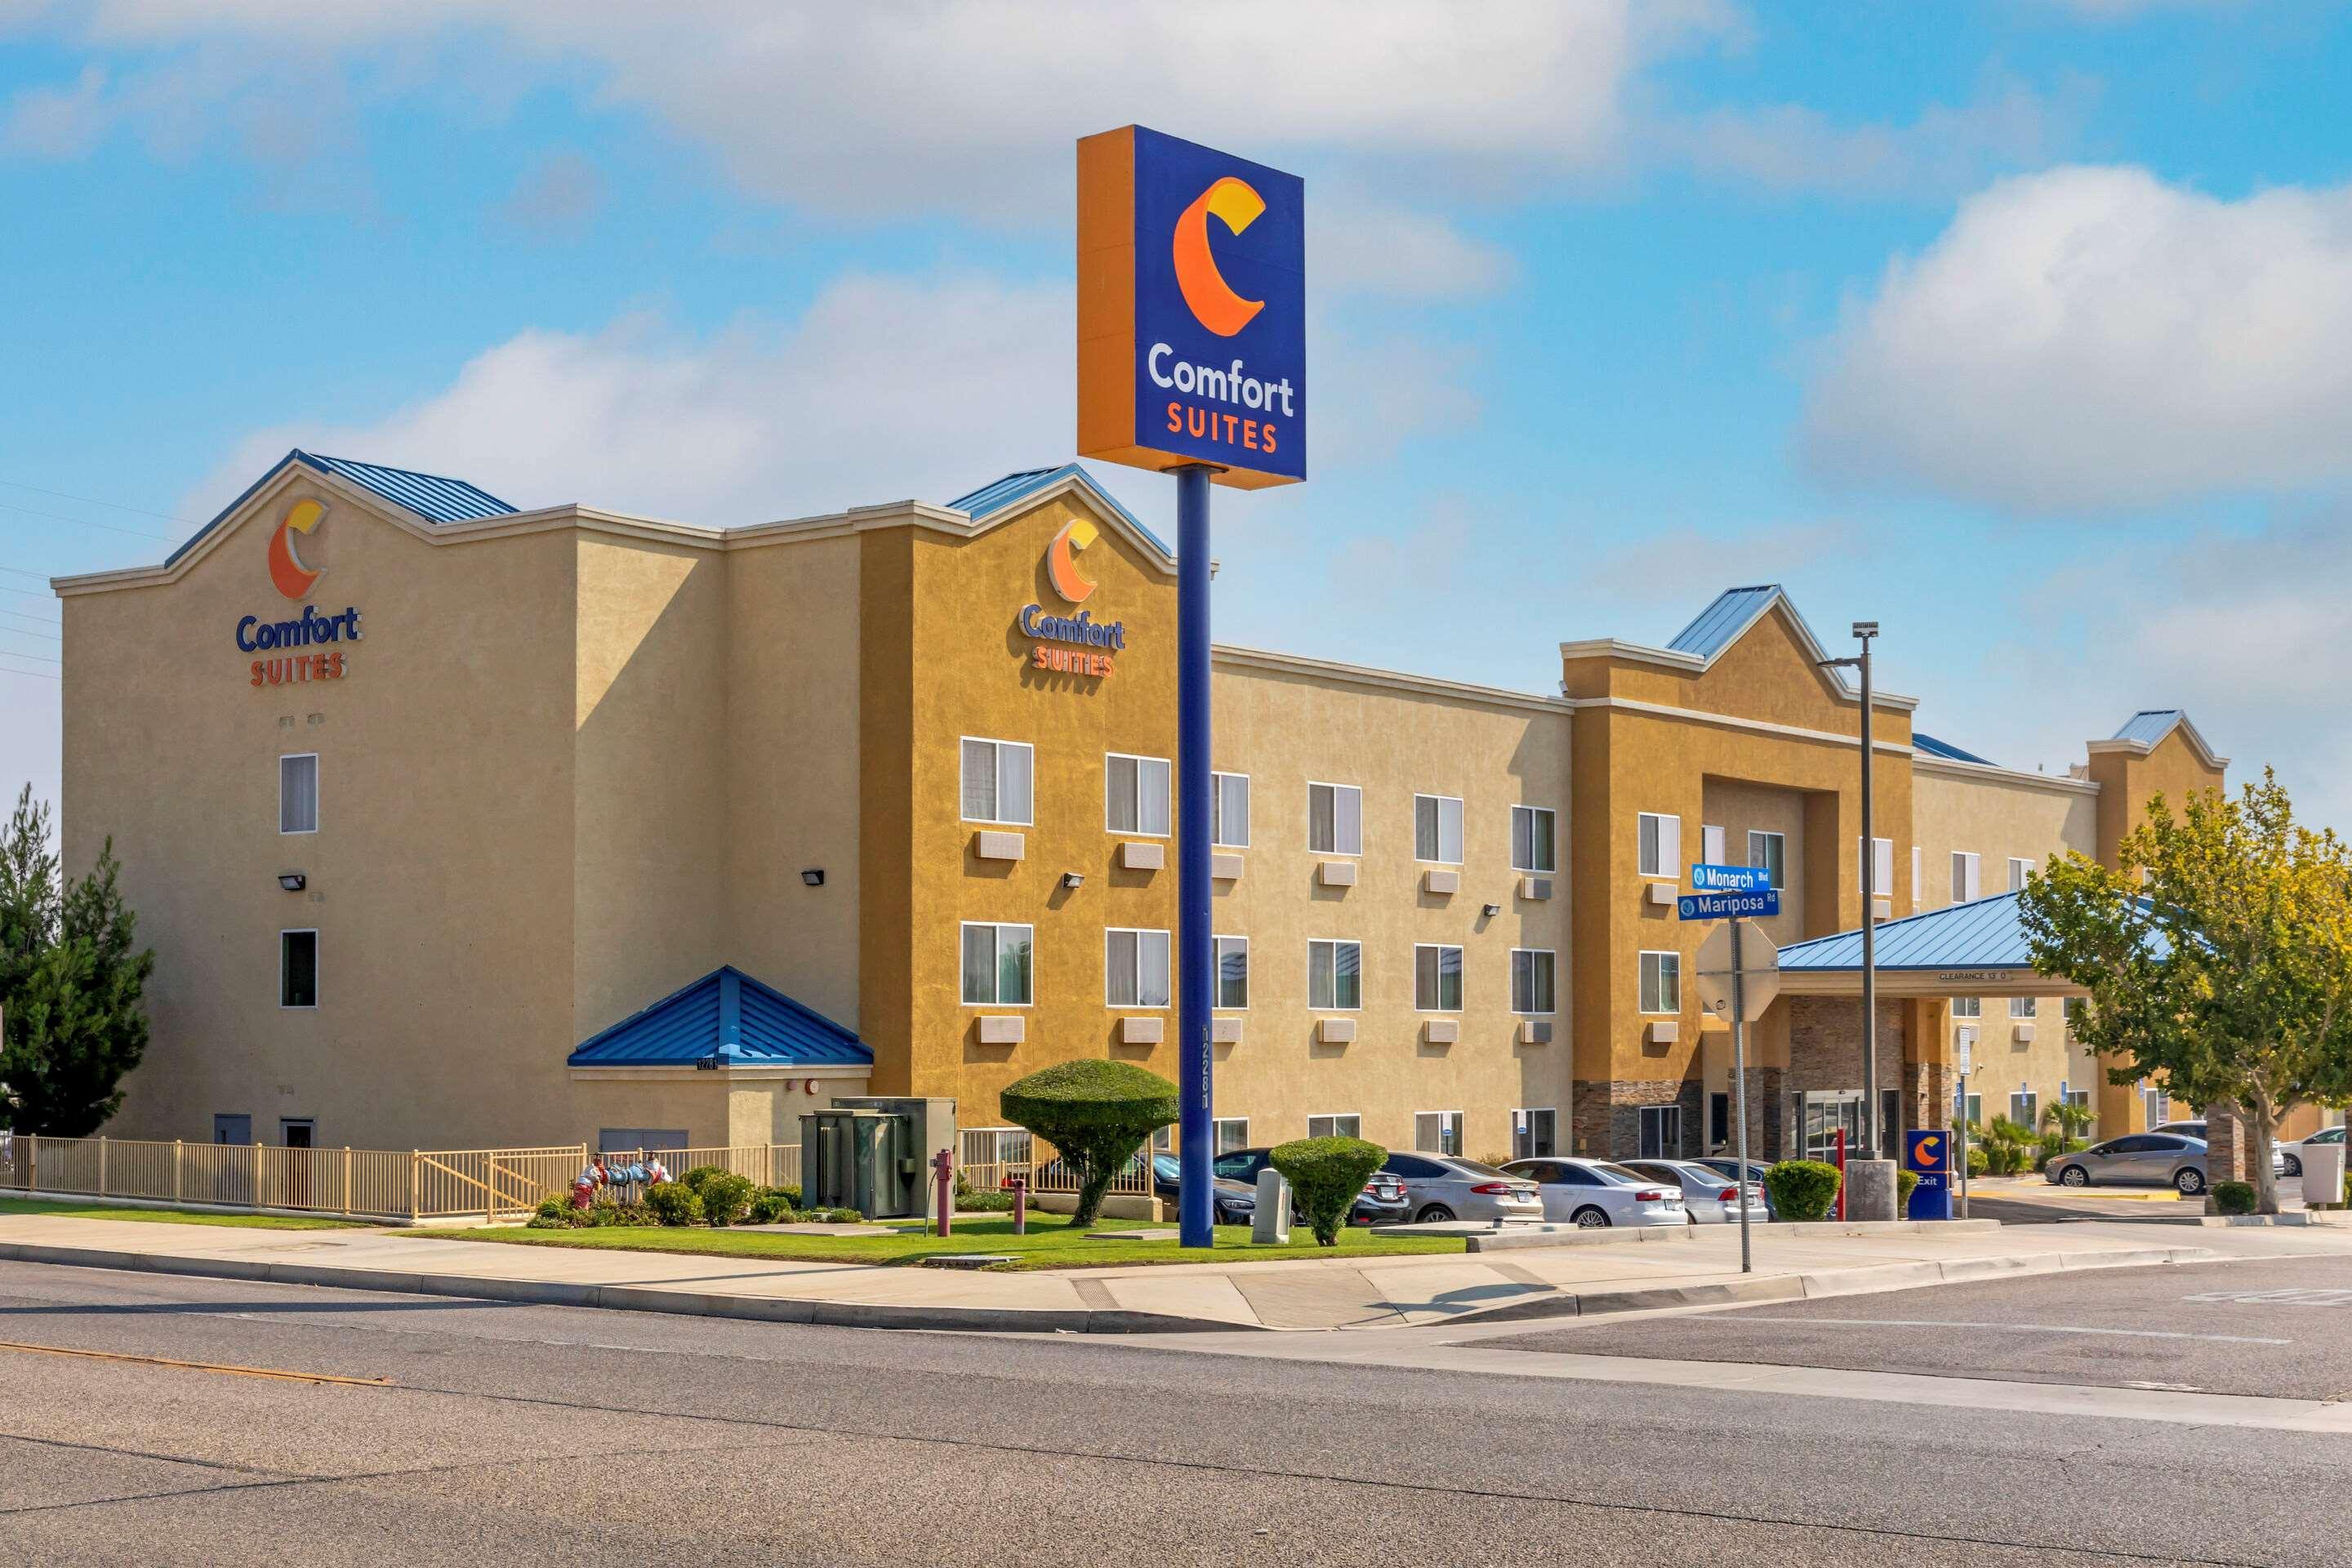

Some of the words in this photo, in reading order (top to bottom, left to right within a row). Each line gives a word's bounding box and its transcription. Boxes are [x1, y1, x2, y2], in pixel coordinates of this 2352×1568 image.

[1148, 342, 1294, 417] Comfort
[1167, 402, 1276, 453] SUITES
[236, 605, 360, 652] Comfort
[1020, 604, 1125, 649] Comfort
[250, 653, 344, 687] SUITES
[1033, 645, 1114, 678] SUITES
[1706, 867, 1753, 889] Monarch
[1698, 895, 1765, 915] Mariposa
[1766, 892, 1776, 902] Rd
[1917, 1175, 1938, 1186] Exit
